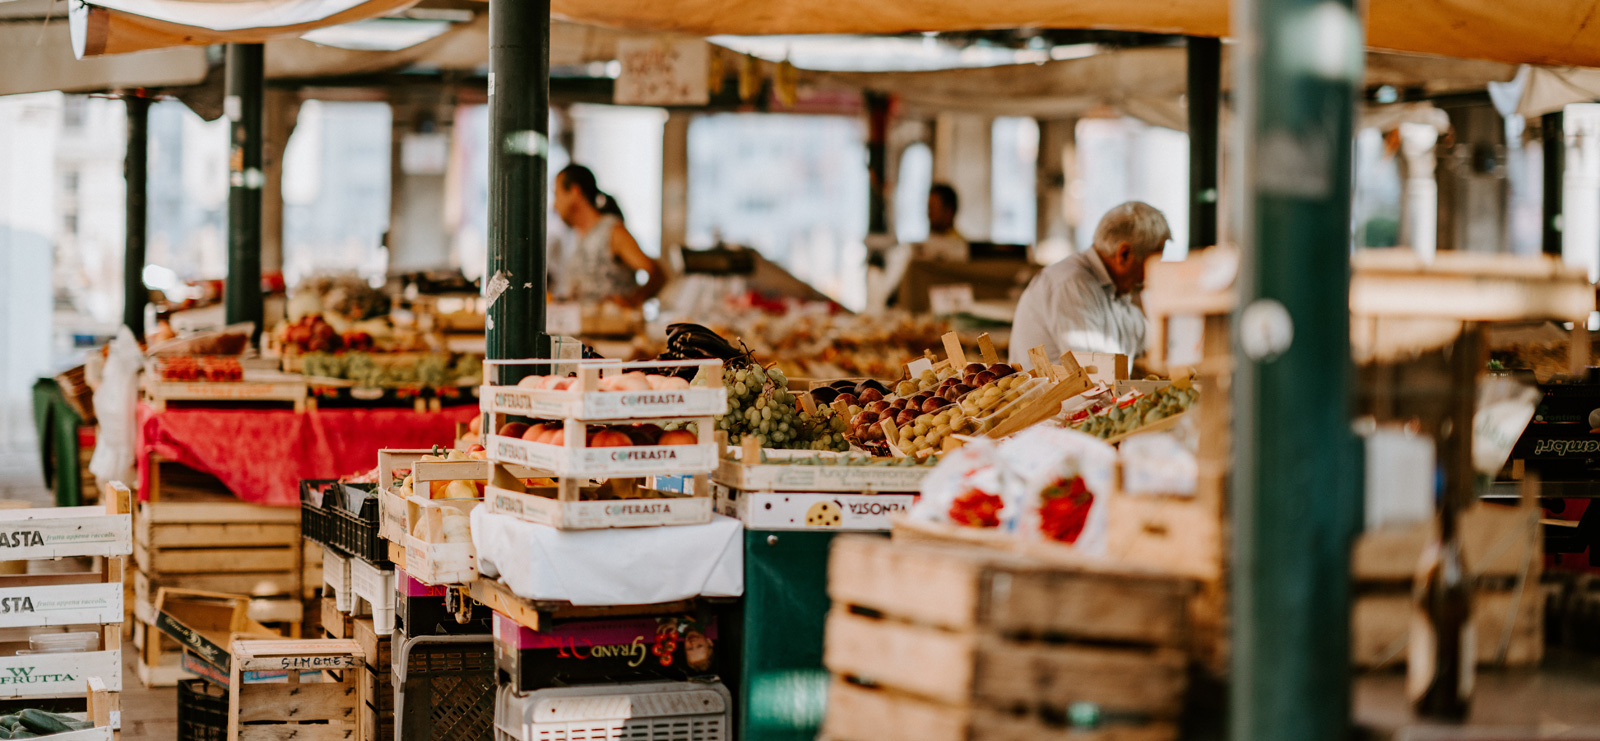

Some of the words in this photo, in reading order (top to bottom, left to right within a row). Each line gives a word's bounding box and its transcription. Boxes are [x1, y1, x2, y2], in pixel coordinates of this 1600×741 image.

[620, 394, 685, 406] COFERASTA
[1534, 439, 1600, 457] embri
[611, 449, 676, 461] COFERASTA
[604, 504, 671, 516] COFERASTA
[0, 596, 35, 613] STA
